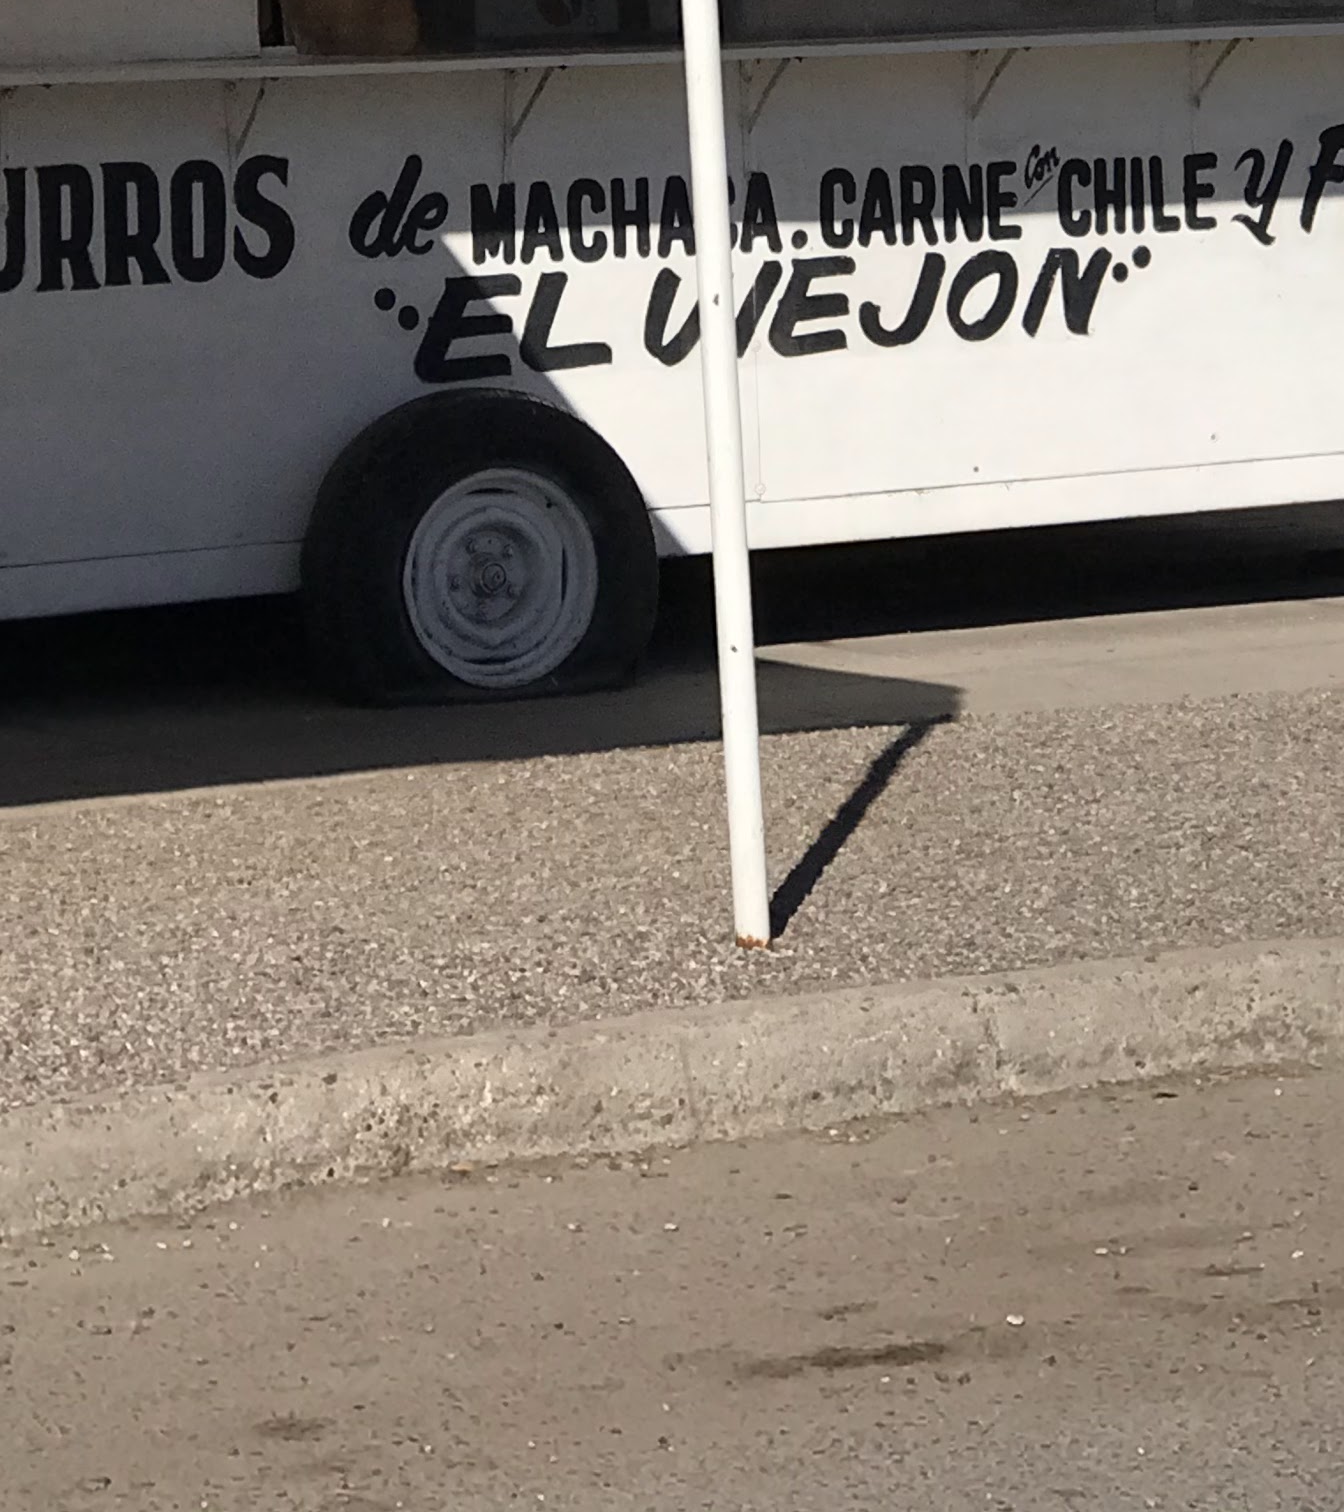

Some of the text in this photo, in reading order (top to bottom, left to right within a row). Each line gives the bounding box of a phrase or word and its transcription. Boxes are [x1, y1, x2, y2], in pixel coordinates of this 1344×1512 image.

[349, 153, 450, 259] de
[819, 161, 1025, 249] CARNE
[1057, 152, 1219, 238] CHILE
[414, 271, 612, 383] EL
